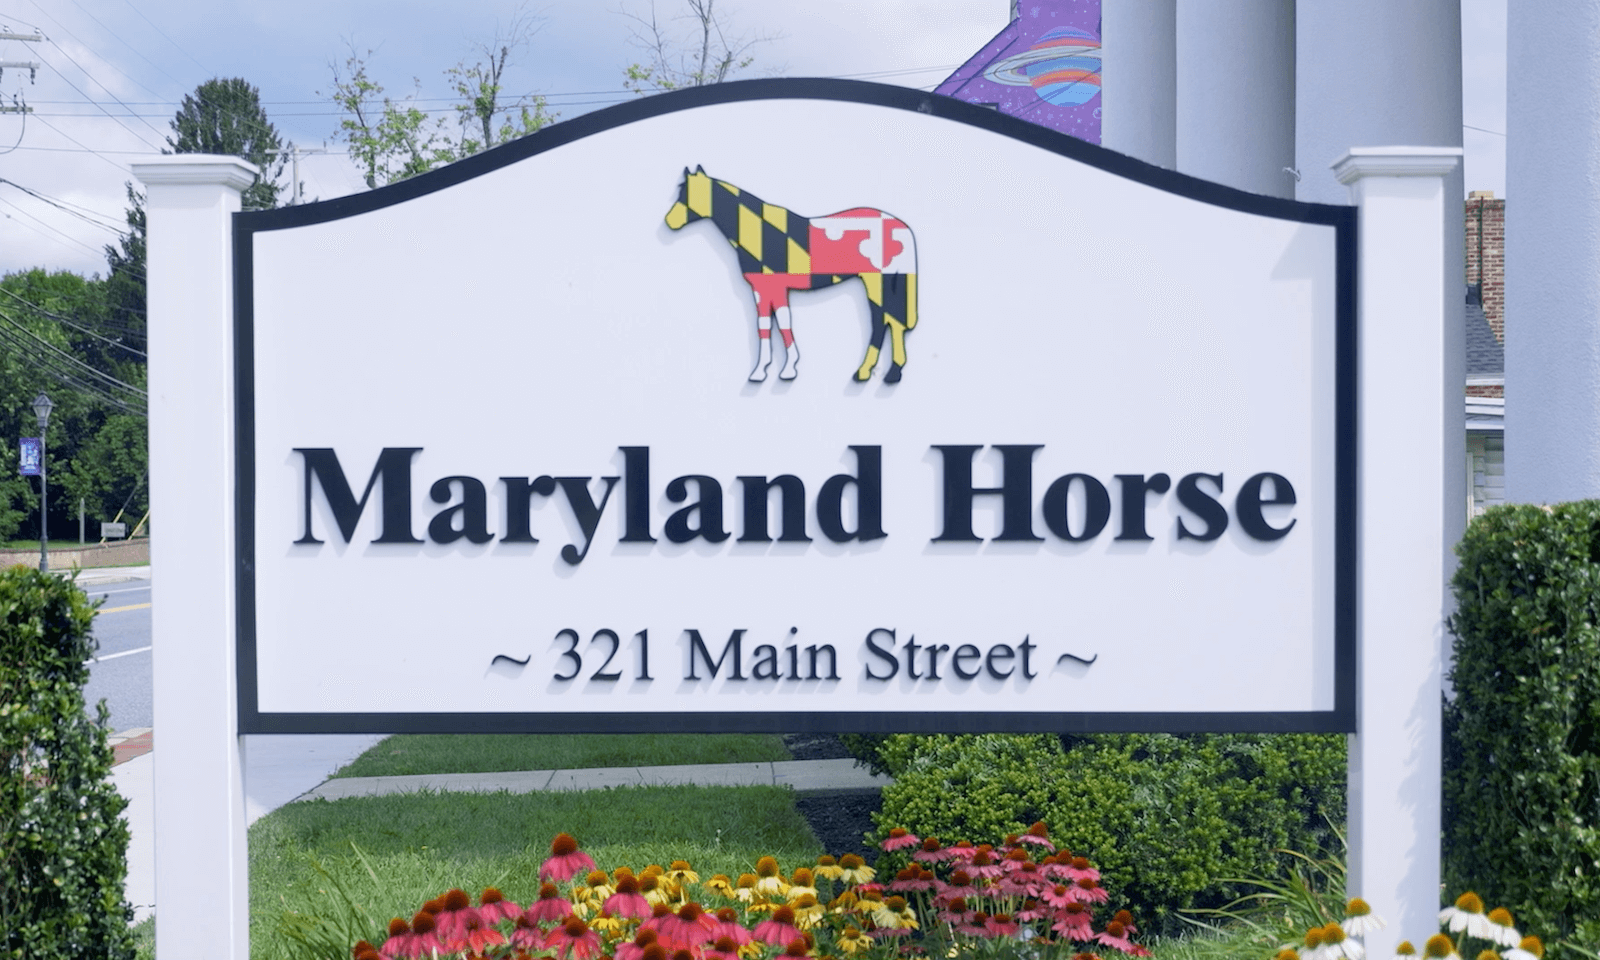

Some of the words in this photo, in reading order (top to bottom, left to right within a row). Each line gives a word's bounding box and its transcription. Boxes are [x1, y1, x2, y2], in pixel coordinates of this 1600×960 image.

[292, 445, 888, 566] Maryland
[930, 444, 1298, 543] Horse
[553, 628, 655, 682] 321
[684, 626, 841, 682] Main
[865, 628, 1038, 682] Street
